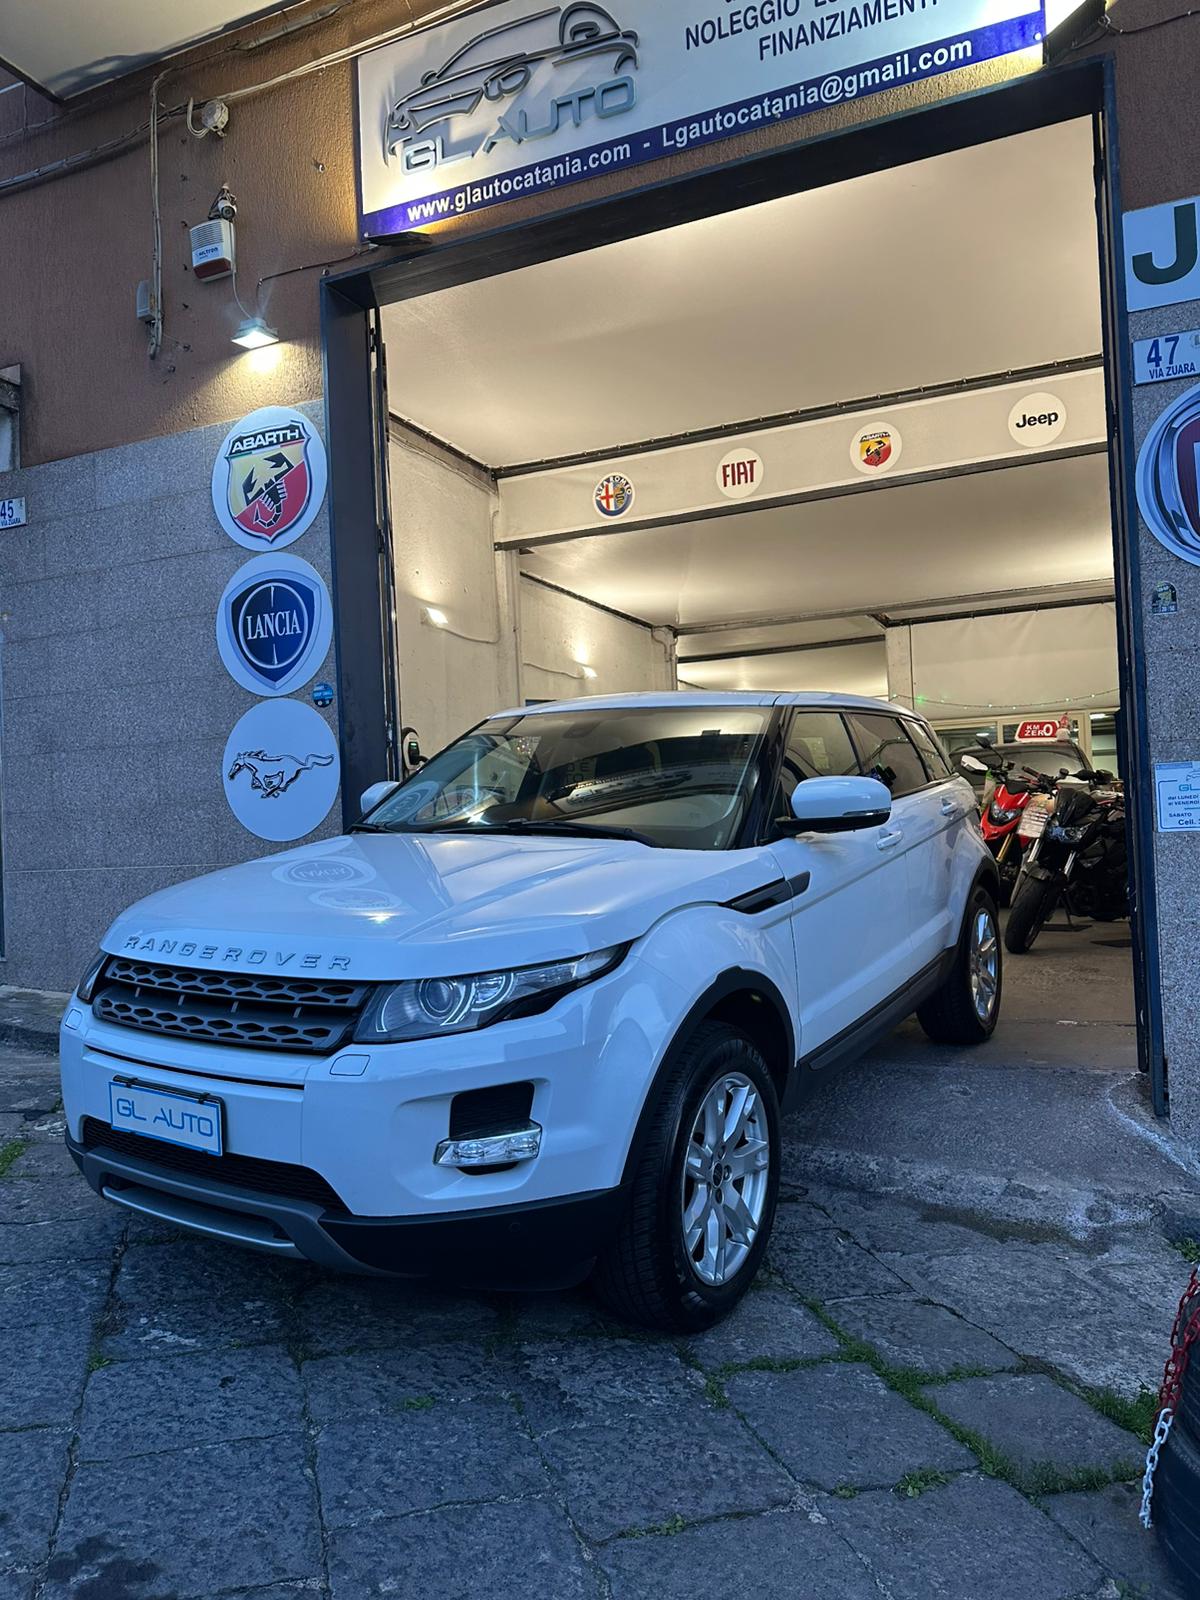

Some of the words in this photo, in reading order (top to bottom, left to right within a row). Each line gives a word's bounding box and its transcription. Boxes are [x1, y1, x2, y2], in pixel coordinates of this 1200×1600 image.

[685, 0, 800, 50] NOLEGGIO
[758, 0, 938, 61] FINANZIAMEN
[401, 135, 475, 176] GL
[482, 75, 636, 154] AUTO
[406, 142, 631, 222] www.glautocatania.com
[662, 39, 973, 149] Lgautocatania@gmail.com
[1146, 335, 1180, 368] 47
[1149, 368, 1164, 380] VIA
[1166, 362, 1196, 377] ZUARA
[1015, 409, 1059, 430] Jeep
[232, 428, 300, 453] ABARTH
[862, 432, 889, 442] ABARTH
[721, 458, 758, 488] FIAT
[0, 500, 14, 519] 45
[247, 609, 302, 640] LANCIA
[116, 1098, 147, 1121] GL
[153, 1108, 214, 1137] AUTO
